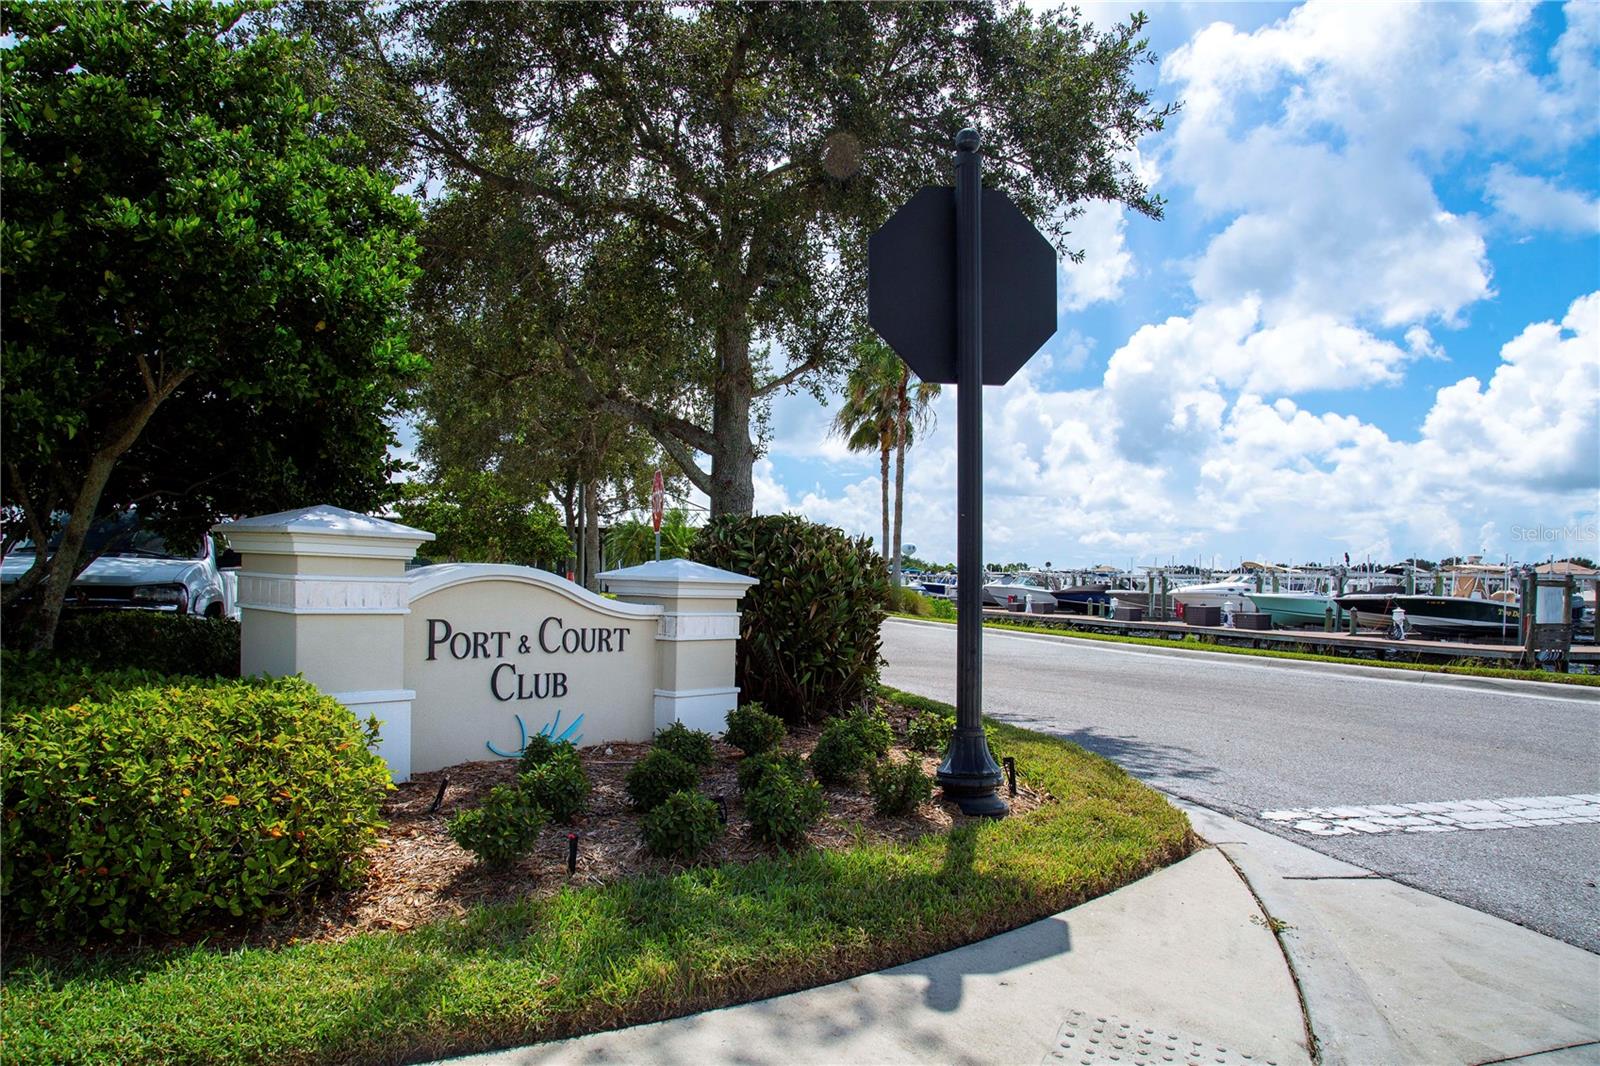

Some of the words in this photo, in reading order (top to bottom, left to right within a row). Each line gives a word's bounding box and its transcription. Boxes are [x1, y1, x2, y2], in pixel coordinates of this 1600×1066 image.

[425, 618, 511, 661] PORT
[517, 634, 531, 654] &
[538, 616, 631, 654] COURT
[490, 662, 568, 702] CLUB
